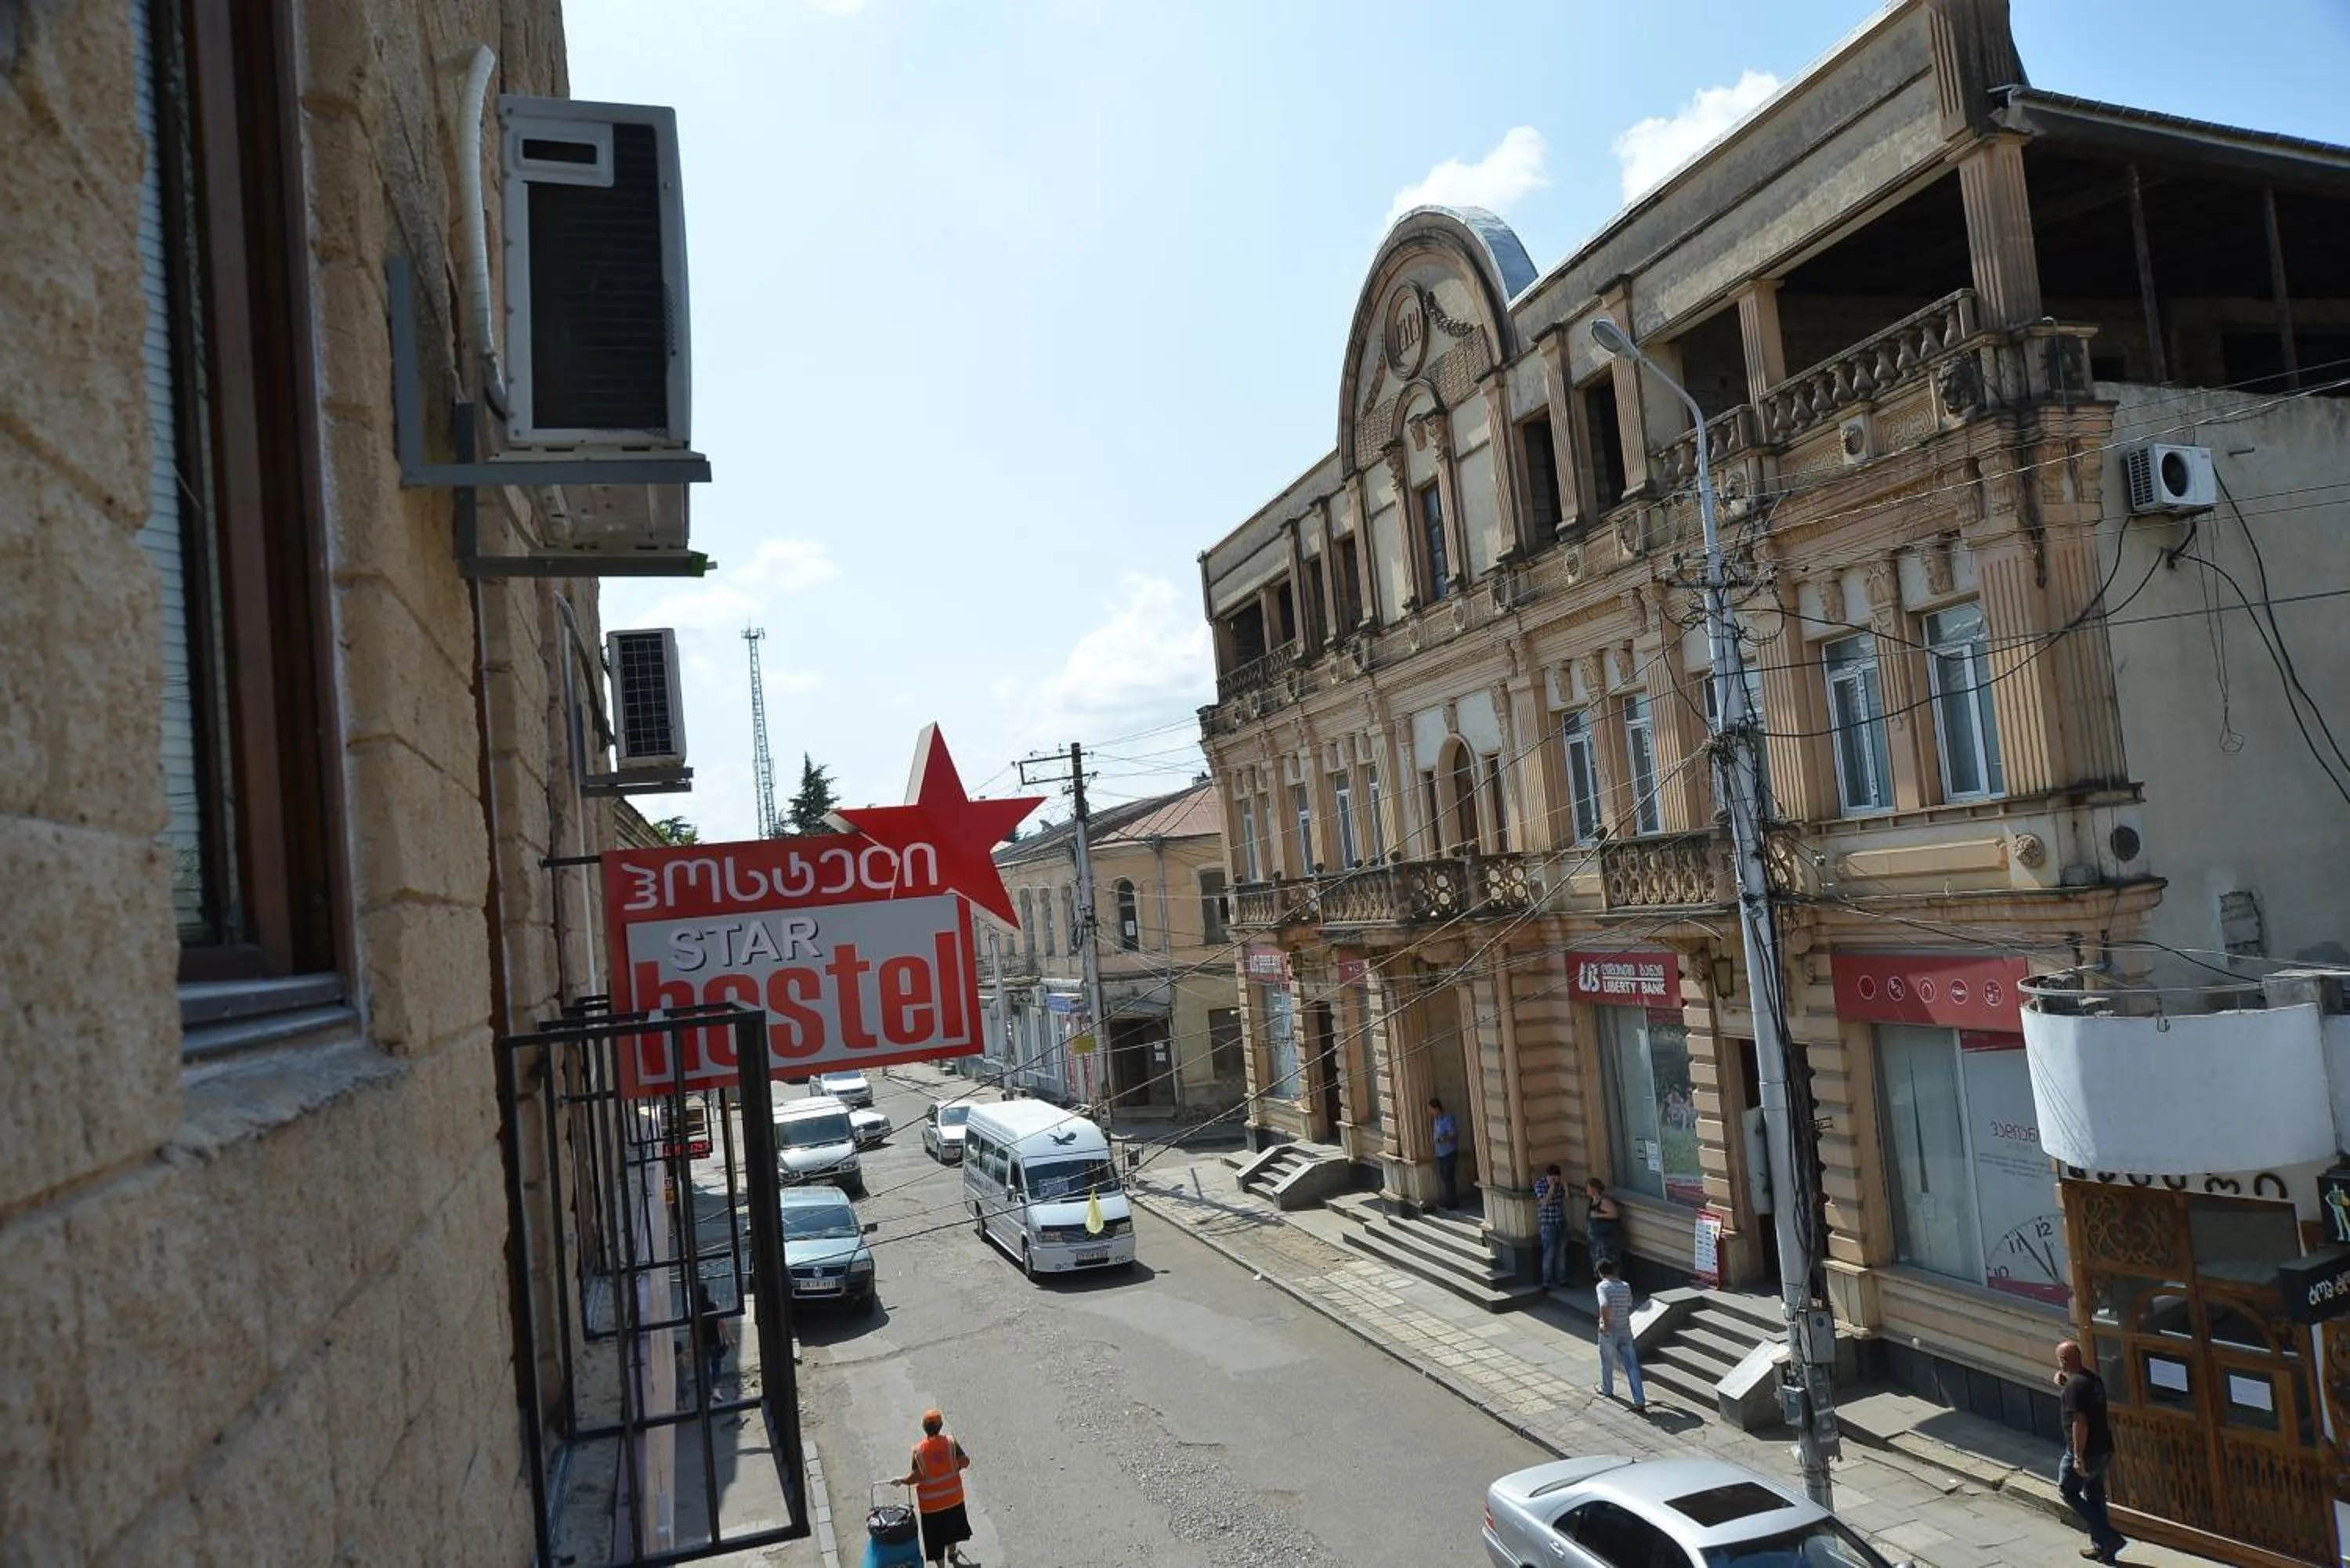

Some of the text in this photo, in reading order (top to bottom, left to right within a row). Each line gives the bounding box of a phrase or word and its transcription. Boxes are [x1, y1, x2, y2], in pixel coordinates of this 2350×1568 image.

[623, 841, 939, 912] ჰოსტელი
[670, 916, 823, 972] STAR
[1603, 980, 1666, 995] LIBERTY BANK
[2035, 1221, 2053, 1238] 12
[2008, 1238, 2023, 1254] 11
